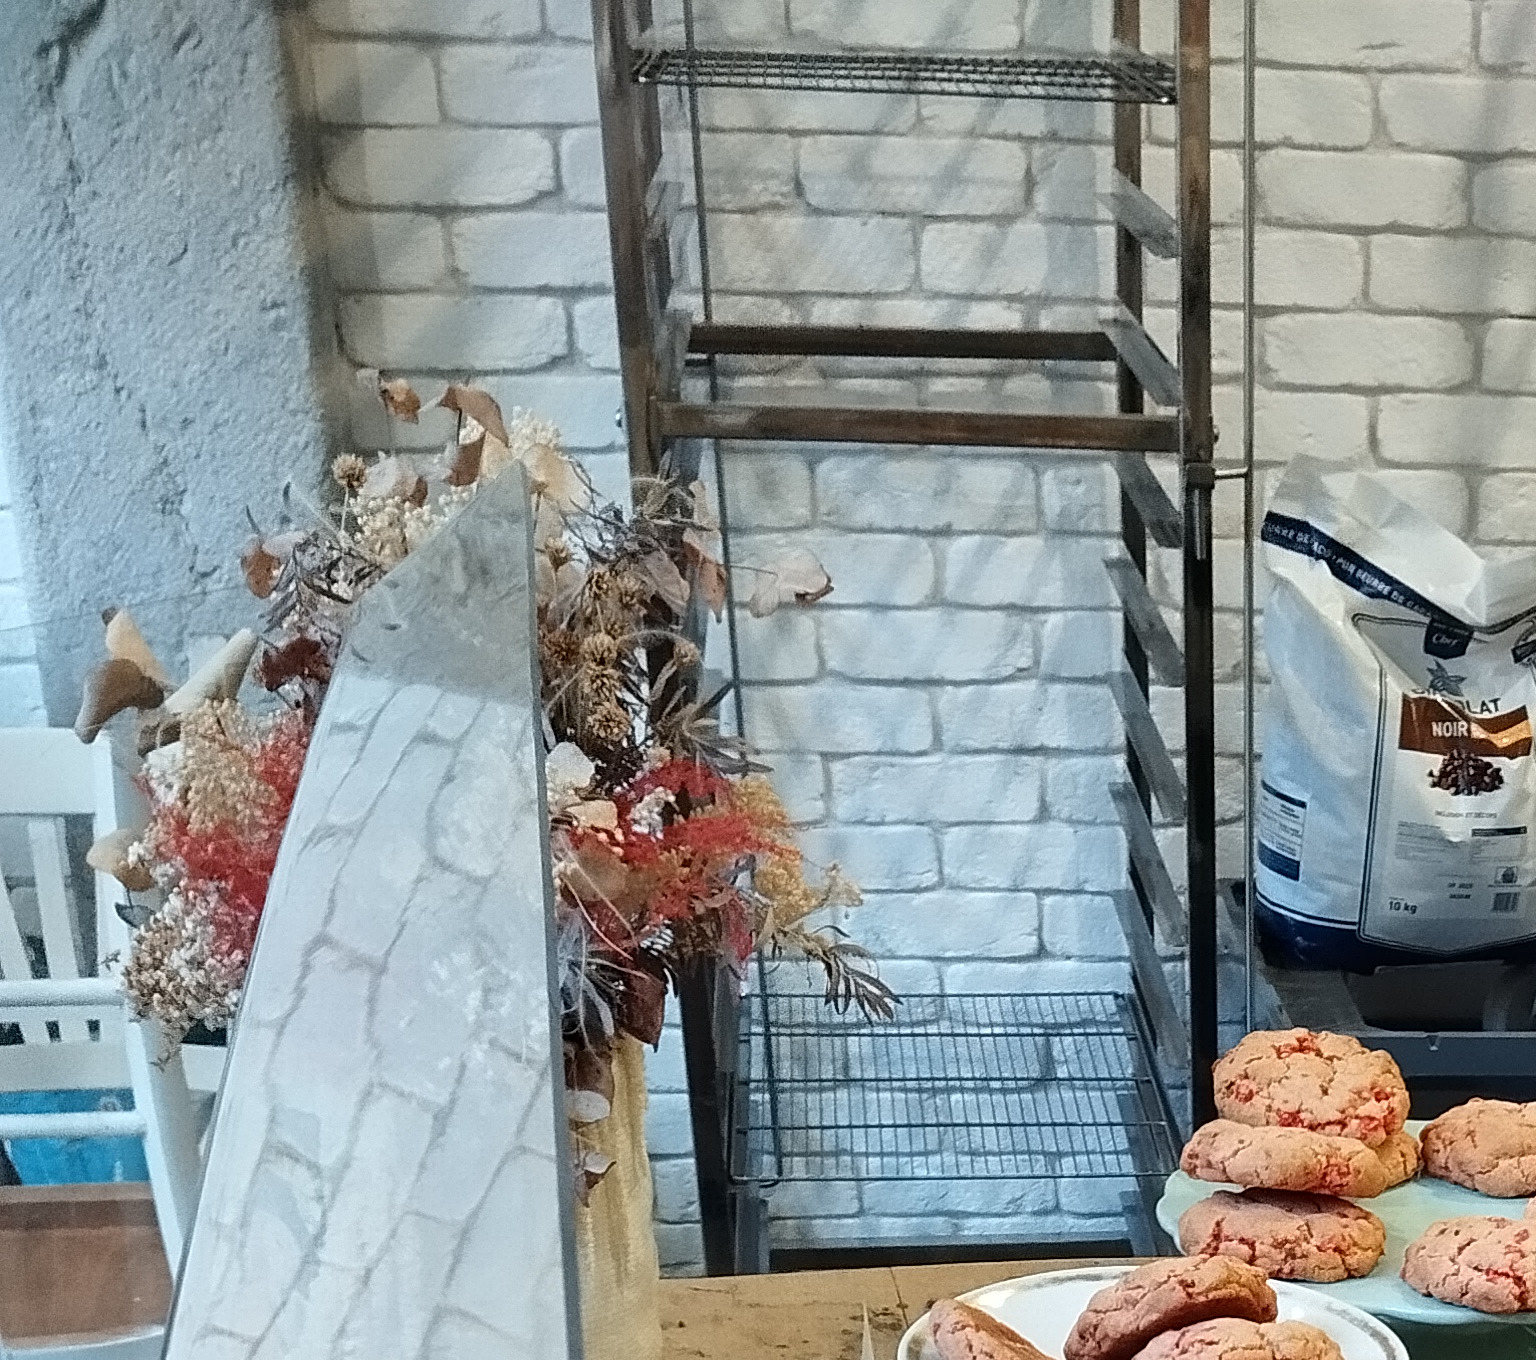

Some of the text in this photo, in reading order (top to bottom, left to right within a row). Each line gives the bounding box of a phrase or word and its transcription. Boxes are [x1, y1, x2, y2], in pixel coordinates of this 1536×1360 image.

[1431, 721, 1469, 738] NOIR
[1389, 900, 1418, 915] 10 kg
